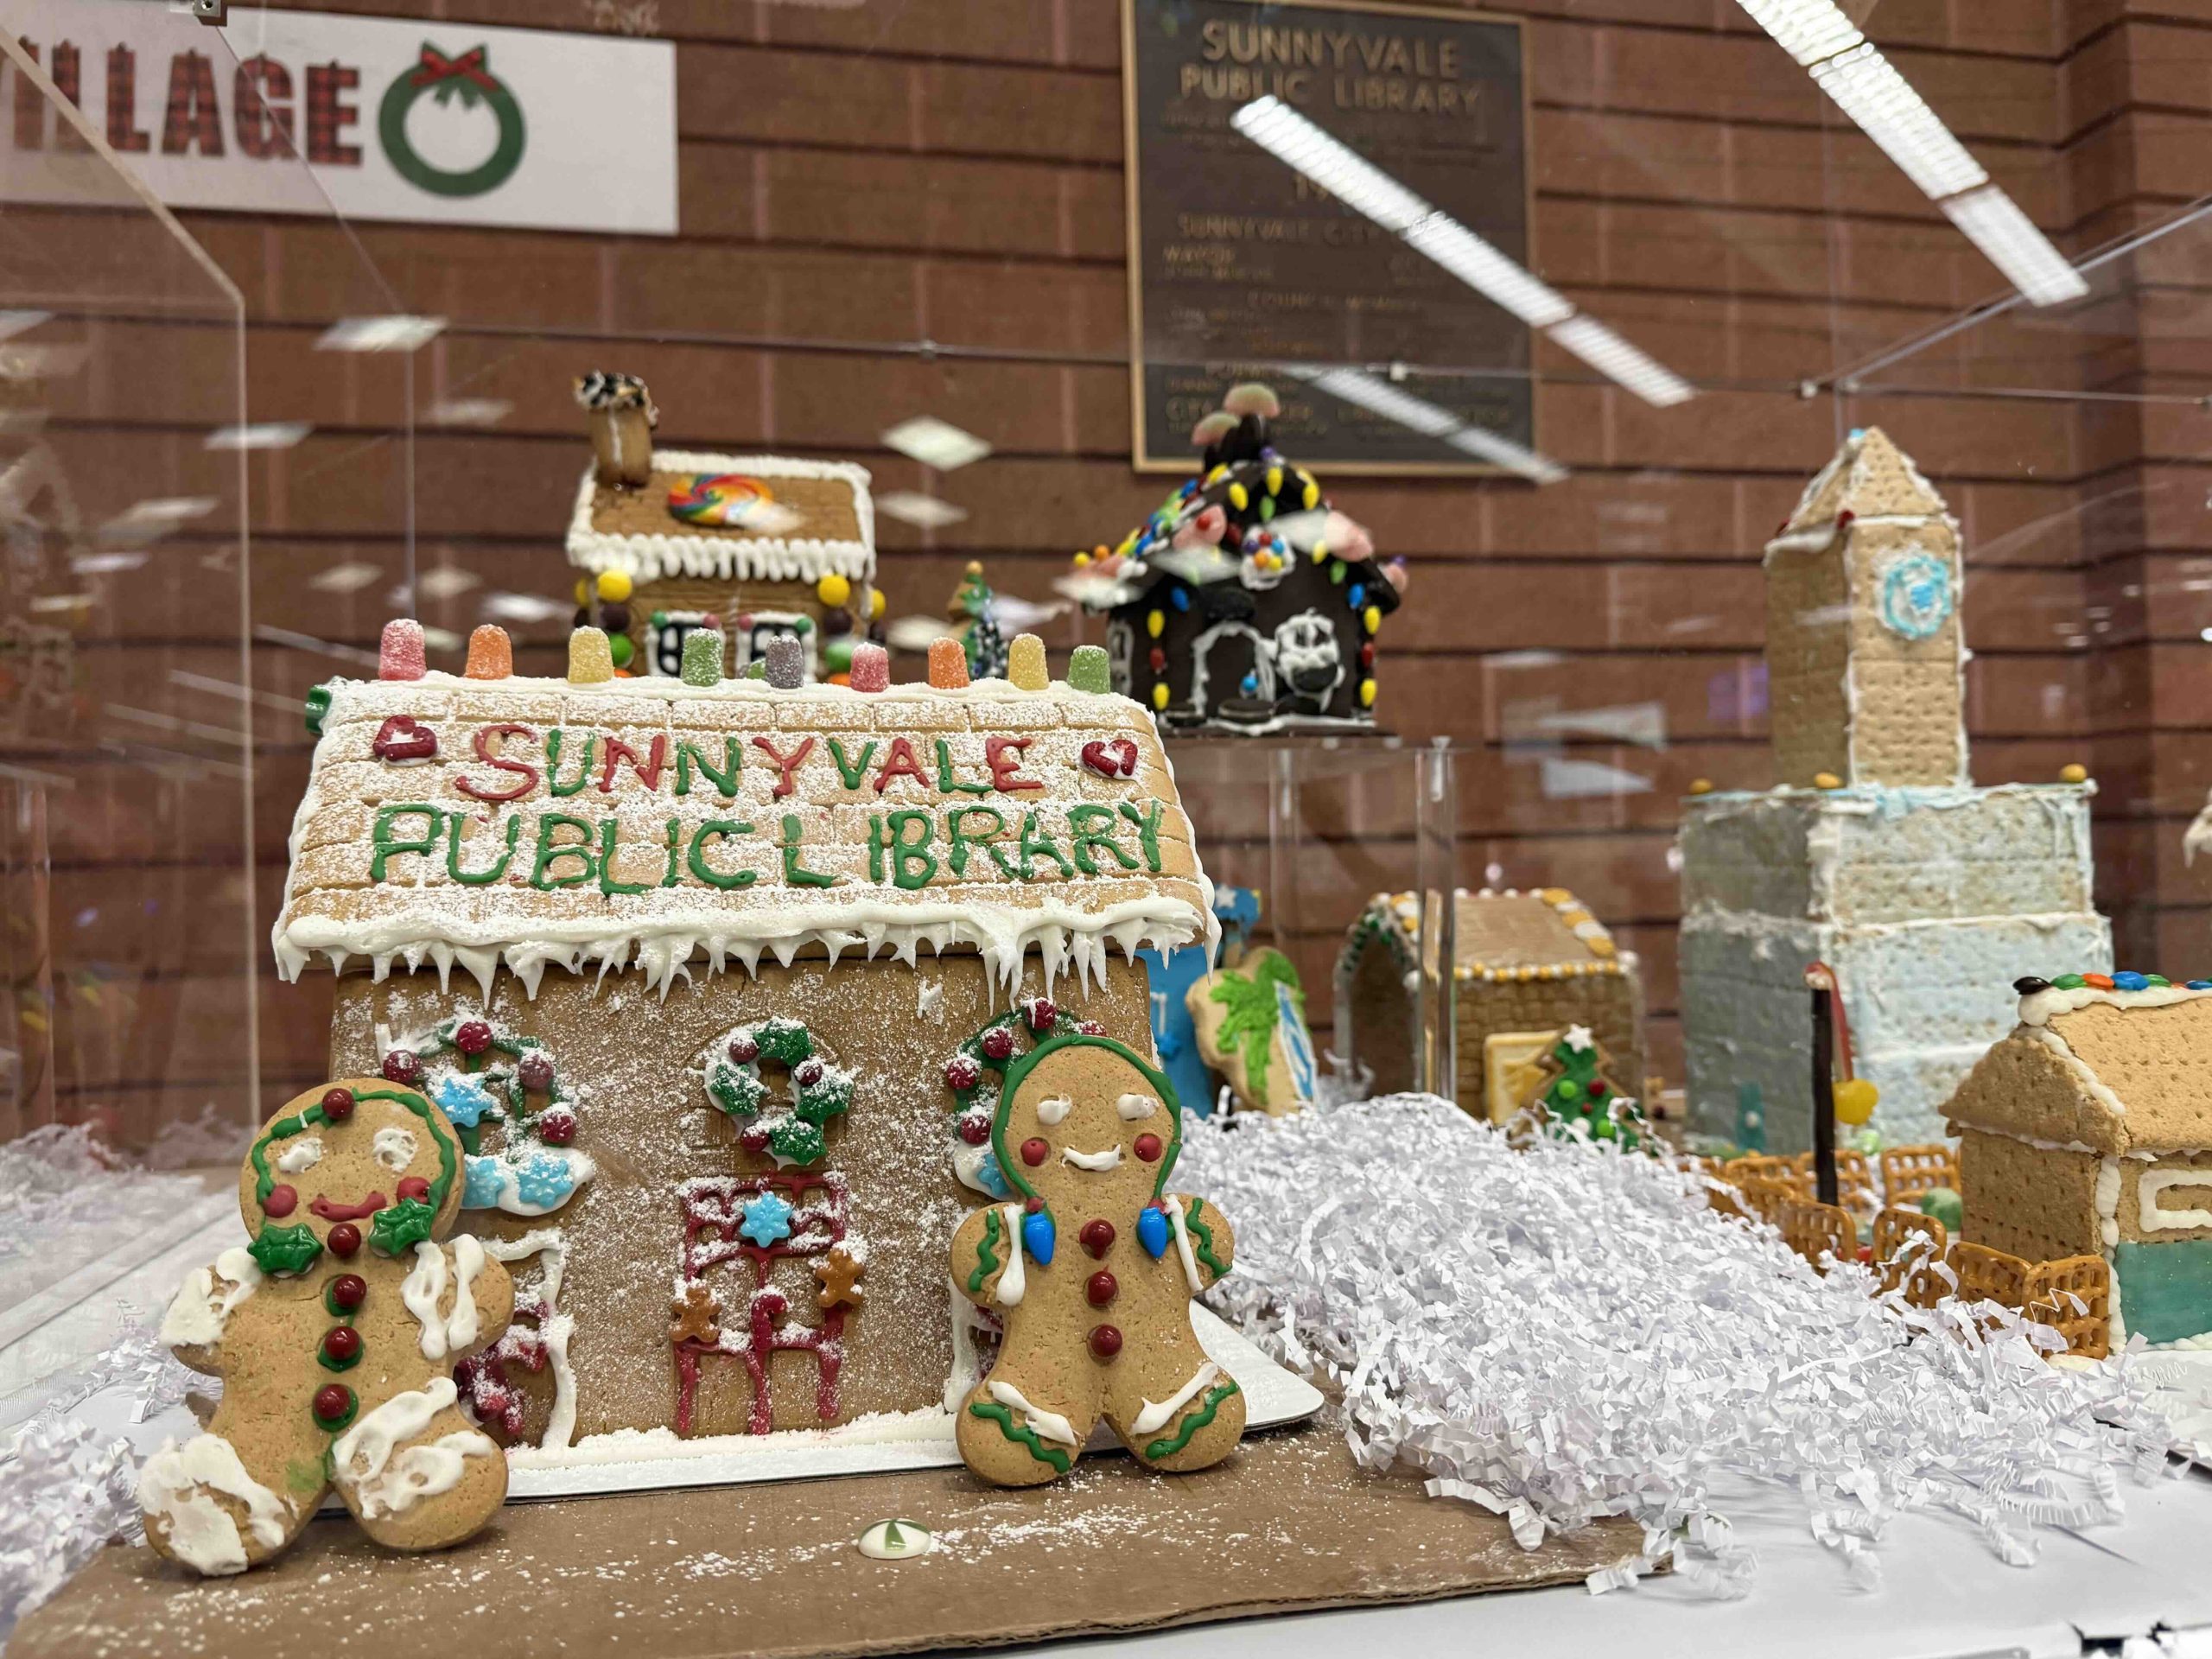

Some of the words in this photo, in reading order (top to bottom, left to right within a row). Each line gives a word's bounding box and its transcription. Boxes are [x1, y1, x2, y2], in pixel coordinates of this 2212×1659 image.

[1201, 19, 1461, 79] SUNNYVALE
[0, 35, 362, 166] ILLAGE
[1179, 63, 1319, 106] PUBLIC
[1334, 76, 1481, 115] LIBRARY
[454, 723, 1043, 800] SUNNYVALE
[370, 803, 758, 895] PUBLIC
[782, 798, 1166, 891] LIBRARY
